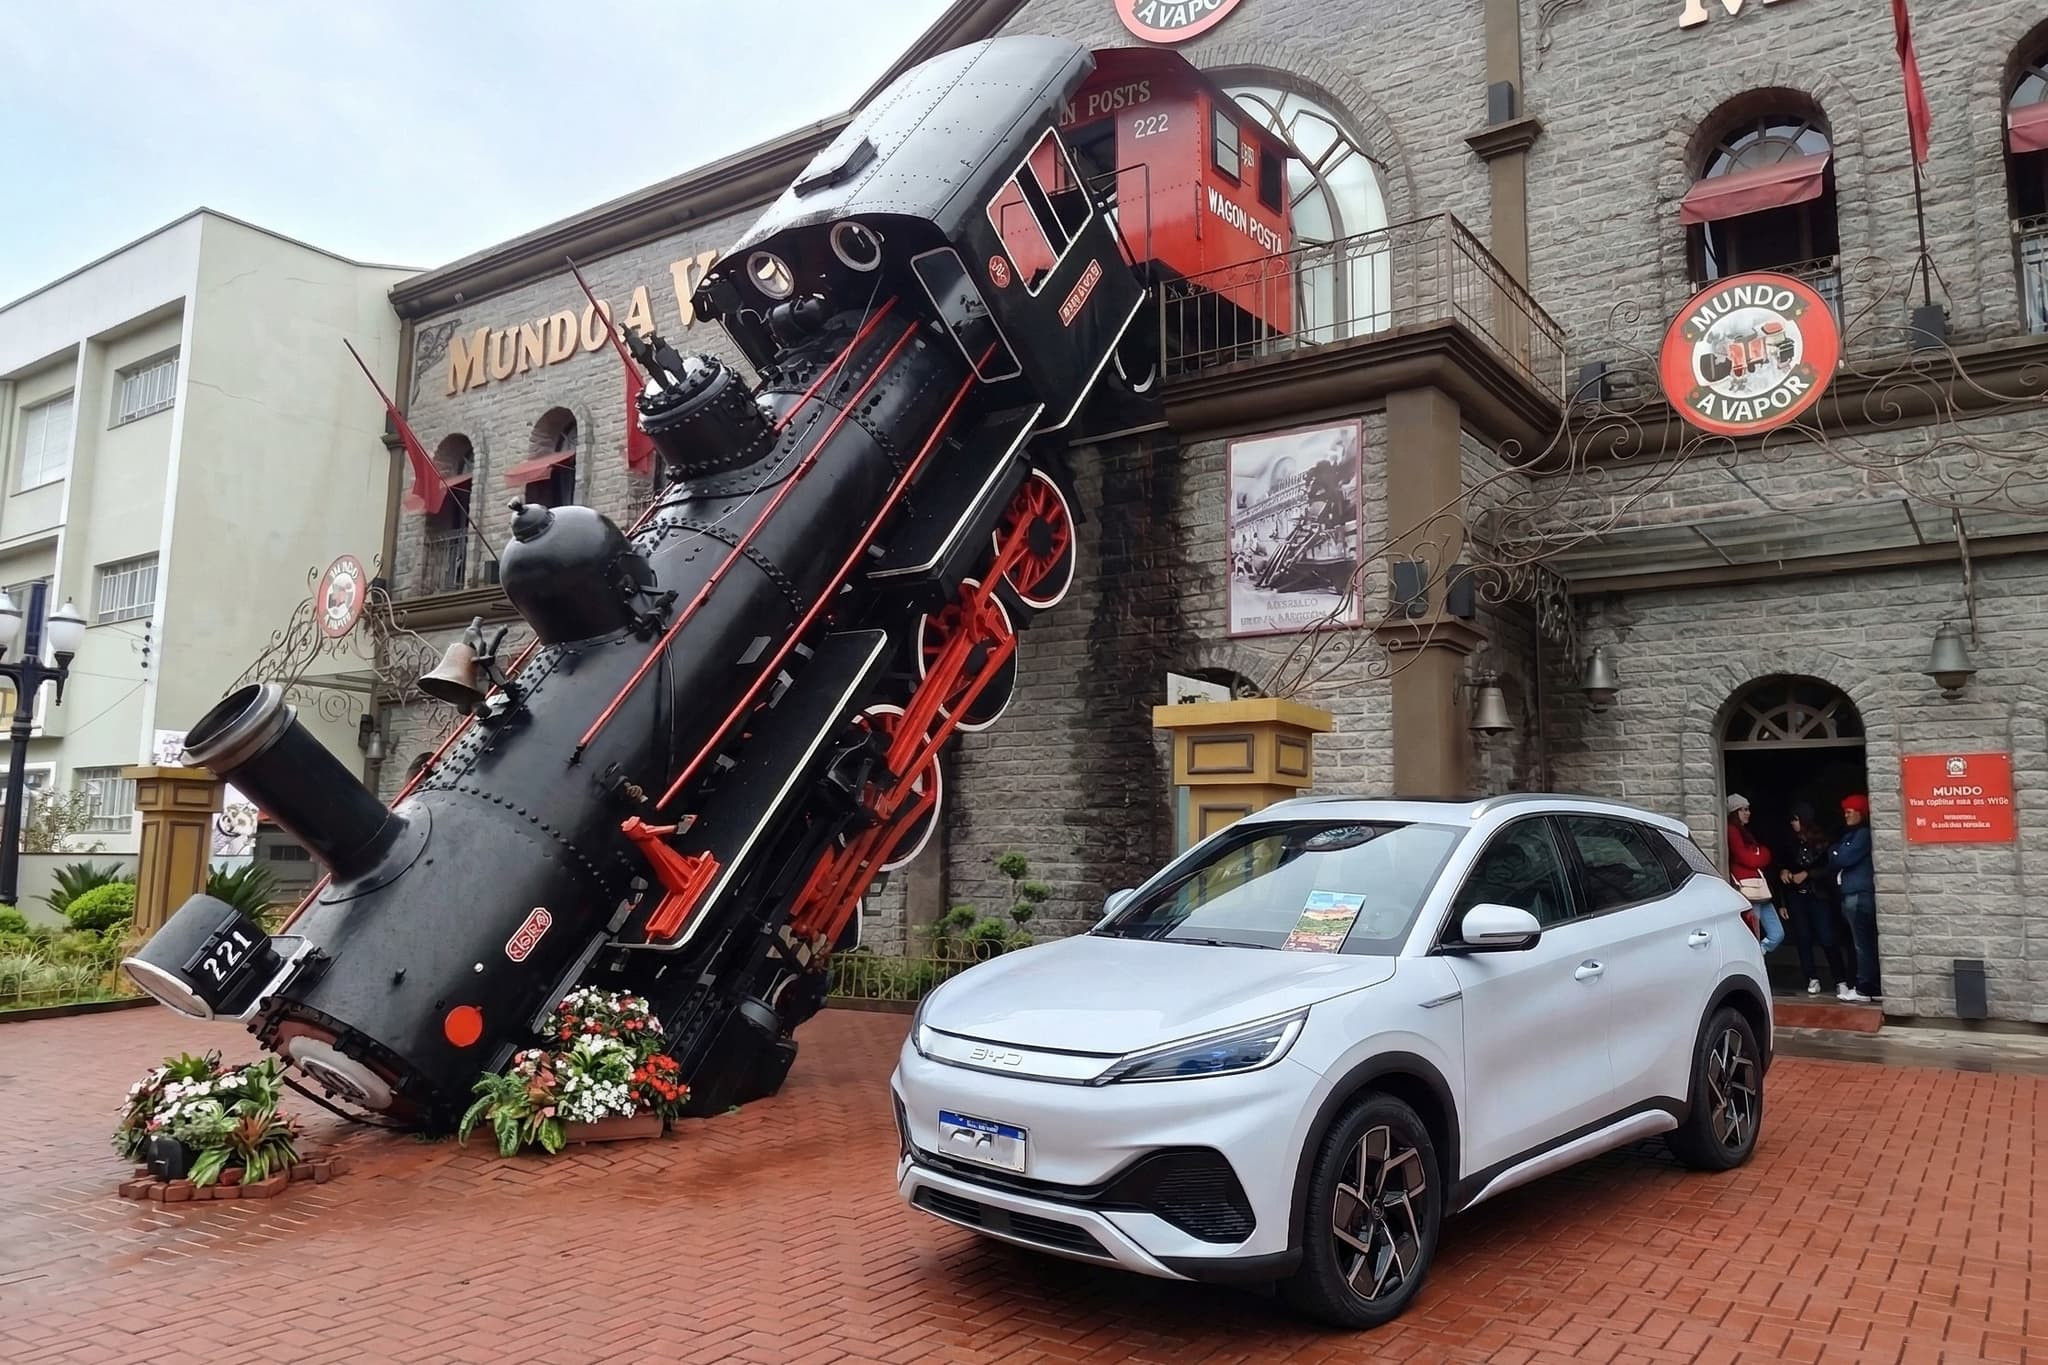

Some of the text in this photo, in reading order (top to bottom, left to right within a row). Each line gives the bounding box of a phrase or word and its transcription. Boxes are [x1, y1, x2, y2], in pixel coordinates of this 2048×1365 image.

[1159, 0, 1221, 27] VAPO
[1088, 80, 1152, 116] POSTS
[1134, 113, 1169, 138] 222
[1207, 185, 1247, 235] WAGON
[1690, 285, 1795, 332] MUNDO
[446, 299, 612, 396] MUNDO
[1696, 375, 1810, 421] A VAPOR
[1933, 786, 1982, 797] MUNDO
[203, 931, 252, 981] 221
[969, 1046, 1024, 1068] BYD
